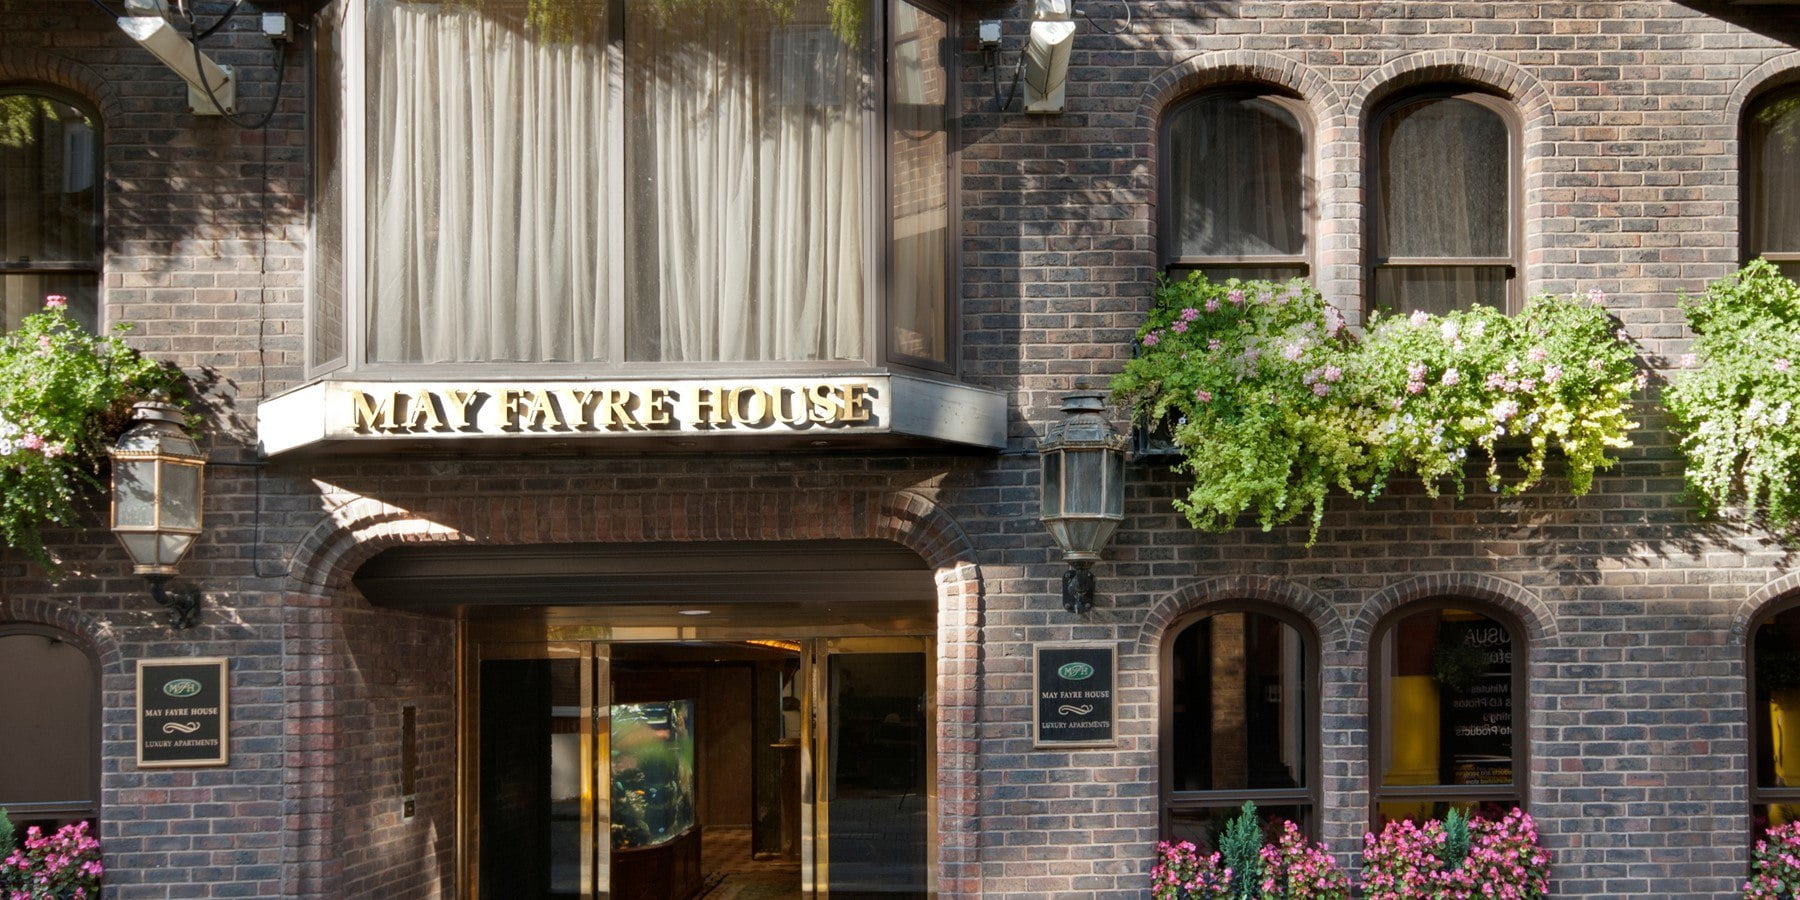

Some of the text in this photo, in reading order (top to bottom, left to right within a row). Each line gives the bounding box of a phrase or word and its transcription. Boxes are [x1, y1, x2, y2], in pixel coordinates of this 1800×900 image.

[347, 382, 870, 429] MAY FAYRE HOUSE
[1042, 691, 1059, 699] MAY
[1084, 690, 1110, 698] HOUSE
[145, 707, 218, 717] MAY FAYRE HOUSE
[1068, 720, 1110, 728] APARTMENTS
[173, 739, 218, 747] APARTMENTS
